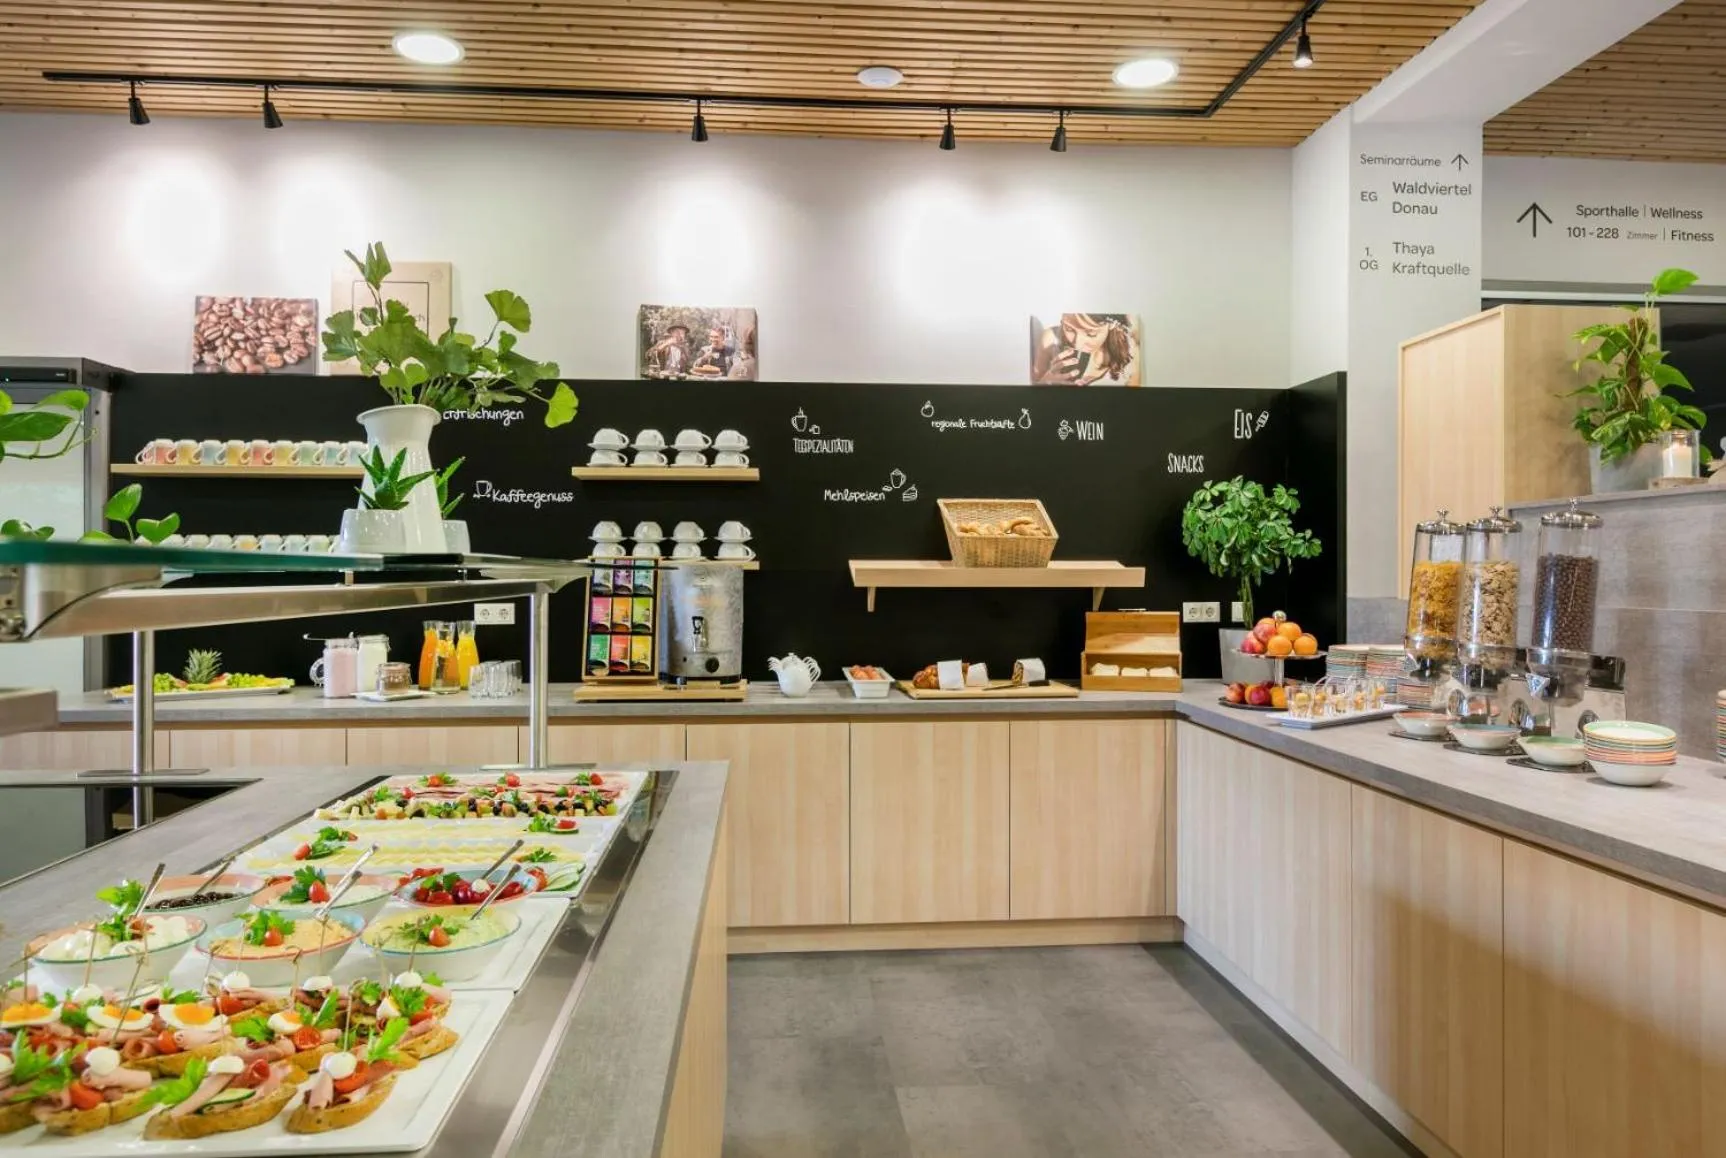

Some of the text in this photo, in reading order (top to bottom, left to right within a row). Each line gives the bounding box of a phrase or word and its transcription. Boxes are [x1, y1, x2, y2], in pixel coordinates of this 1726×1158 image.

[1360, 153, 1441, 167] Seminarräume
[1392, 181, 1472, 196] Waldviertel
[1360, 191, 1378, 202] EG
[1392, 201, 1438, 215] Donau
[1576, 204, 1704, 220] Sporthalle Wellness
[1626, 231, 1658, 240] Zimmer
[1671, 229, 1715, 242] Fitness
[1392, 241, 1435, 257] Thaya
[1359, 260, 1379, 271] OG
[1392, 261, 1471, 277] Kraftquelle
[1075, 419, 1105, 440] WEIN
[1234, 408, 1253, 439] EIS
[1167, 451, 1205, 474] SNACKS
[492, 488, 574, 509] Kaffeegenuss
[824, 488, 886, 502] Mehlspeisen
